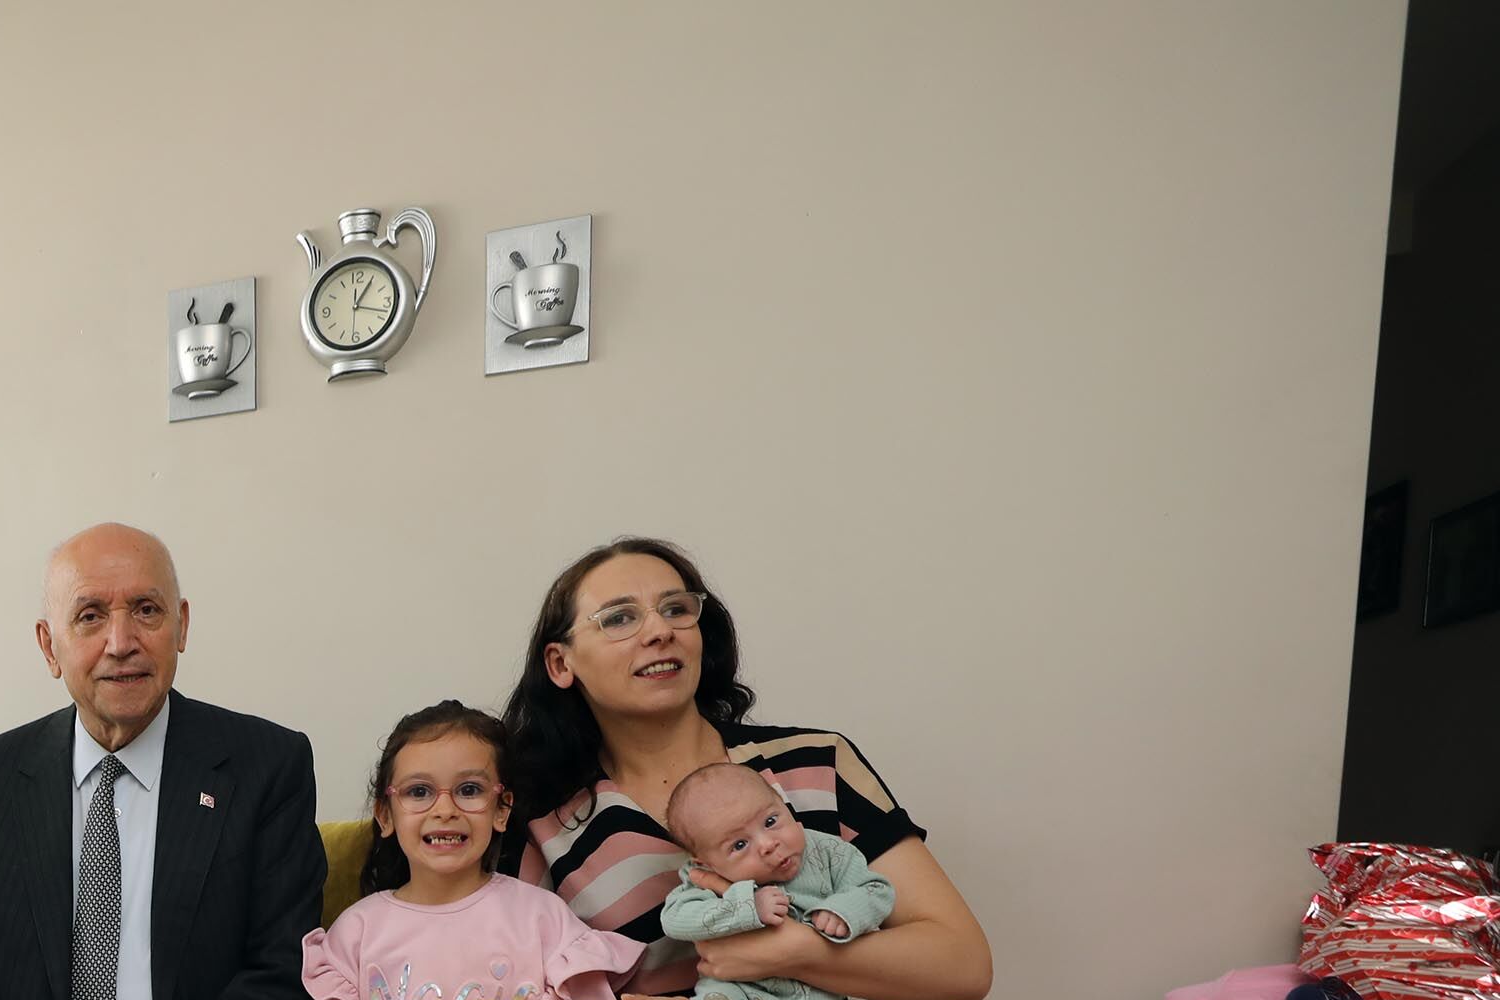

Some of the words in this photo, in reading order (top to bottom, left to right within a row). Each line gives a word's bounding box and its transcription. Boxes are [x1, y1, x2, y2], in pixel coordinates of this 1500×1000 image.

[351, 271, 365, 284] 12
[383, 296, 392, 309] 3
[322, 306, 331, 319] 9
[351, 331, 361, 343] 6
